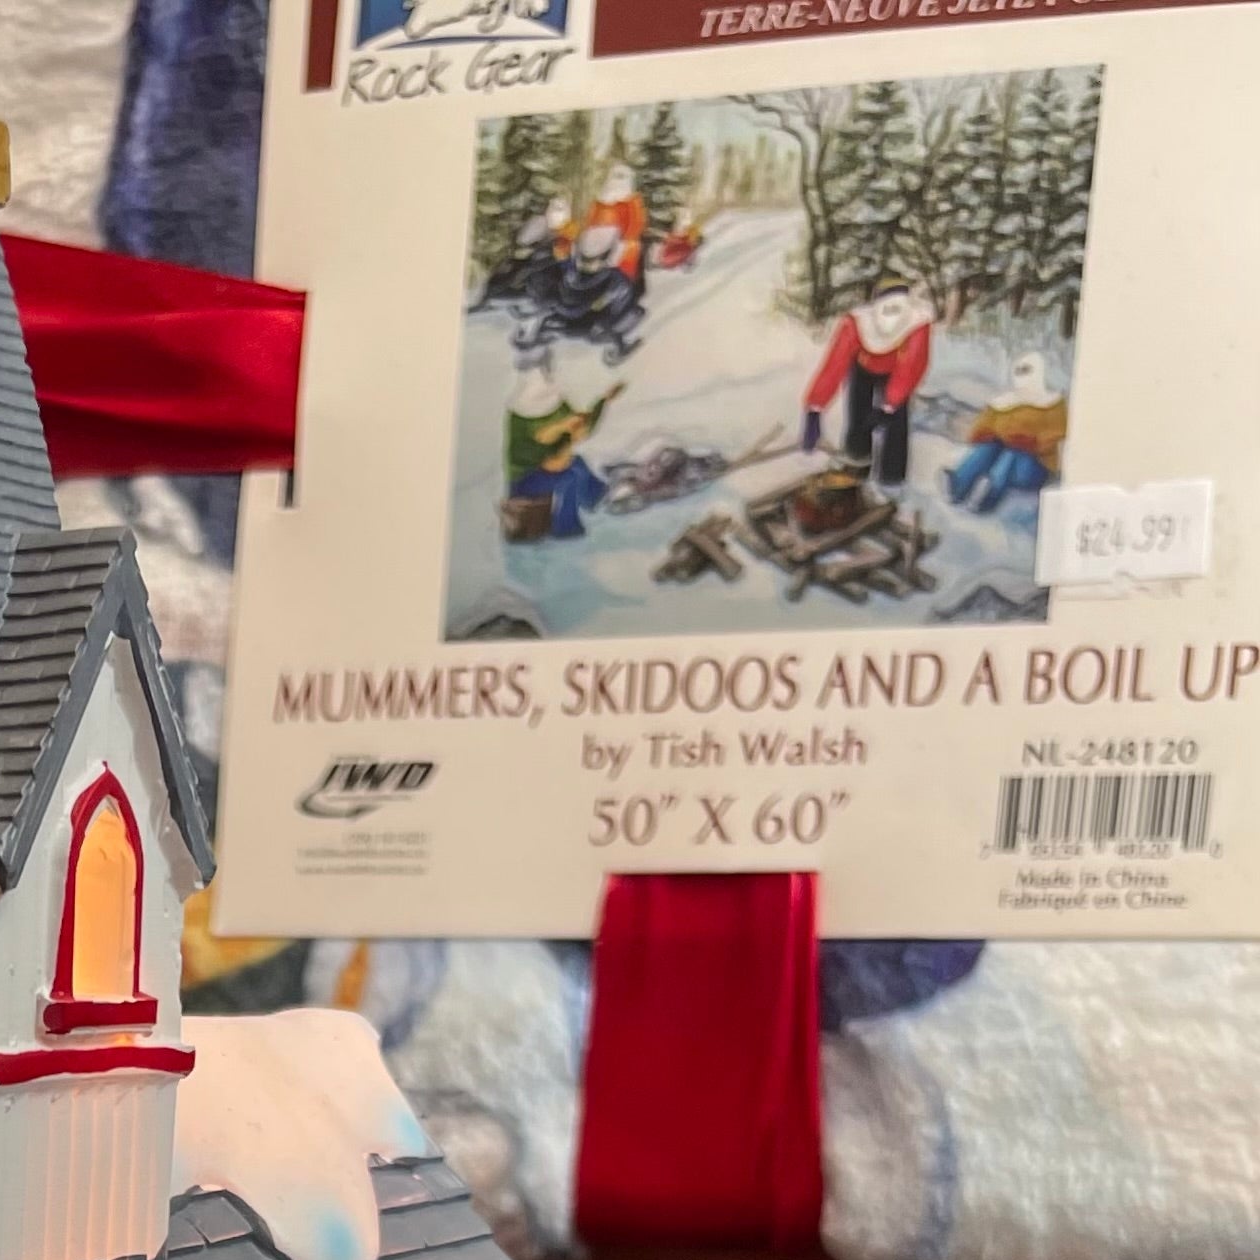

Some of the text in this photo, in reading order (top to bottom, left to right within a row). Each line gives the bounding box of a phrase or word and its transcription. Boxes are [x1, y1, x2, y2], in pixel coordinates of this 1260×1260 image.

[341, 40, 575, 107] Rock Gear
[273, 640, 1260, 728] MUMMERS, SKIDOOS AND A BOIL UP
[580, 727, 869, 781] by Tish Walsh
[1021, 738, 1201, 767] NL-248120
